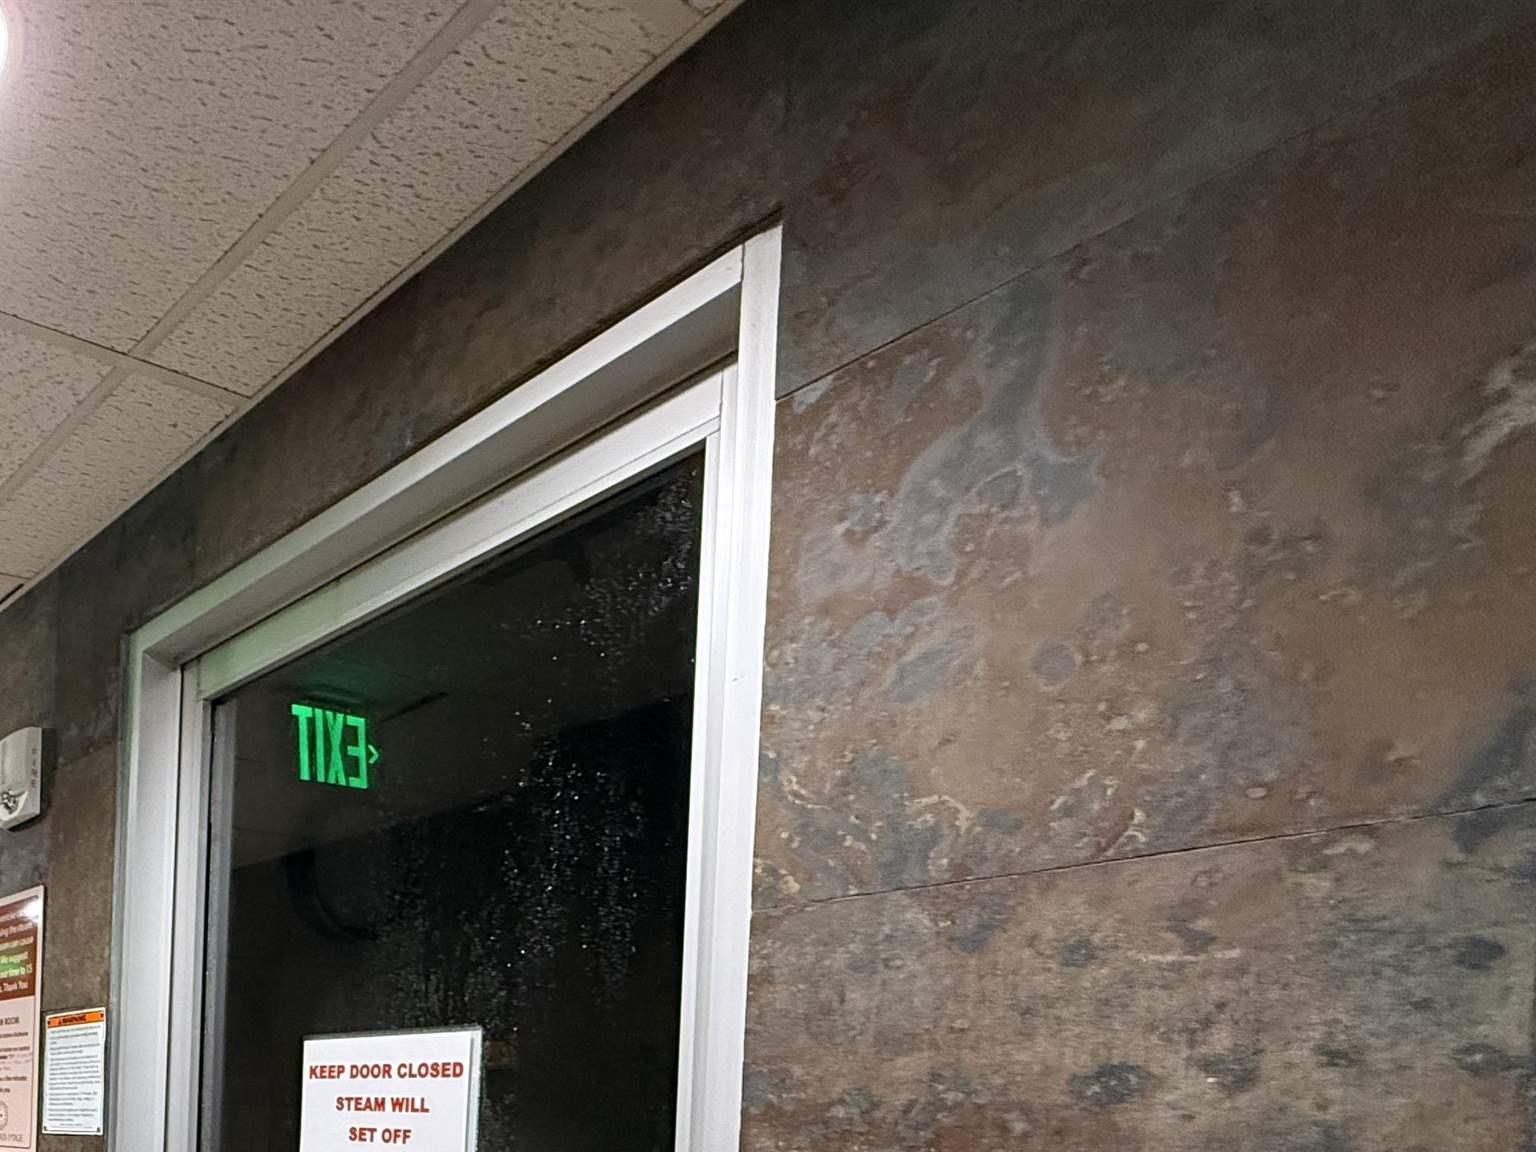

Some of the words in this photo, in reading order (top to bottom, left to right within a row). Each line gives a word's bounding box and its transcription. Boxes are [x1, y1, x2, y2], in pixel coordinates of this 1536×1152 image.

[309, 1065, 345, 1079] KEEP
[350, 1064, 392, 1079] DOOR
[397, 1062, 464, 1078] CLOSED
[336, 1097, 385, 1112] STEAM
[391, 1097, 430, 1113] WILL
[349, 1127, 377, 1142] SET
[381, 1128, 411, 1144] OFF
